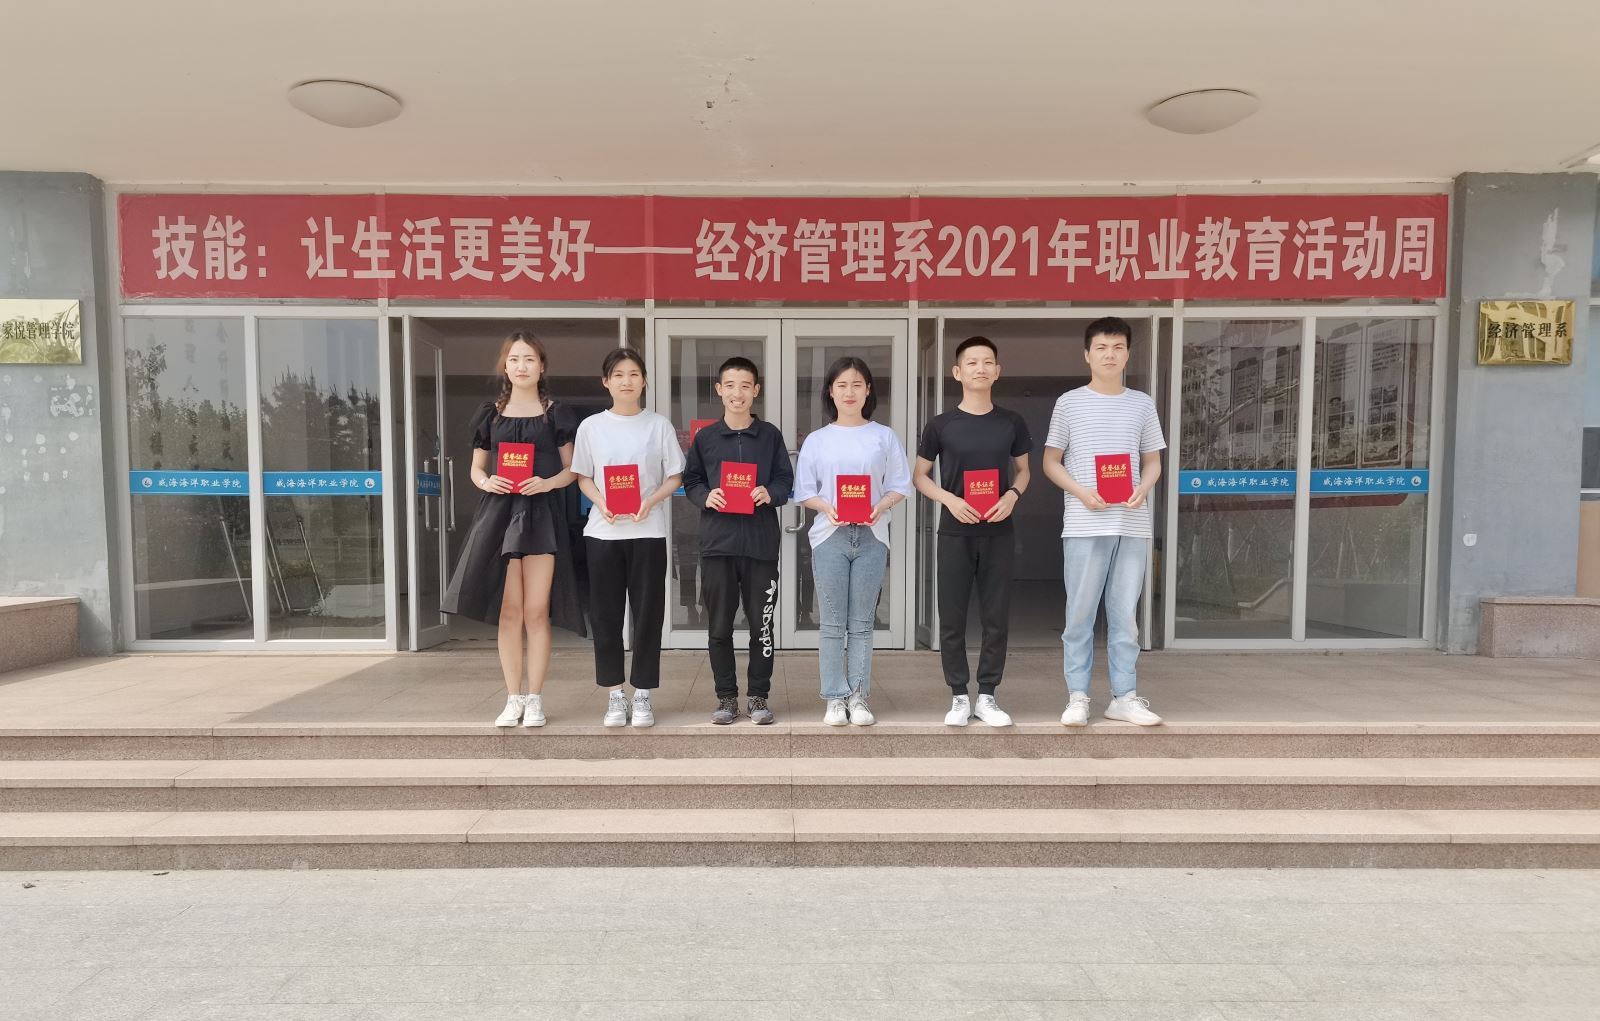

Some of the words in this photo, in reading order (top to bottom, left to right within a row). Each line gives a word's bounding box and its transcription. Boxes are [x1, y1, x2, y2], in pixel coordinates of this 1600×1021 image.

[1487, 322, 1567, 338] 经济管理系
[158, 477, 242, 489] 威海海洋职业学院
[275, 477, 360, 489] 威海海洋职业学院
[1206, 476, 1291, 488] 威海海洋职业学院
[1322, 476, 1406, 487] 威海海洋职业学院
